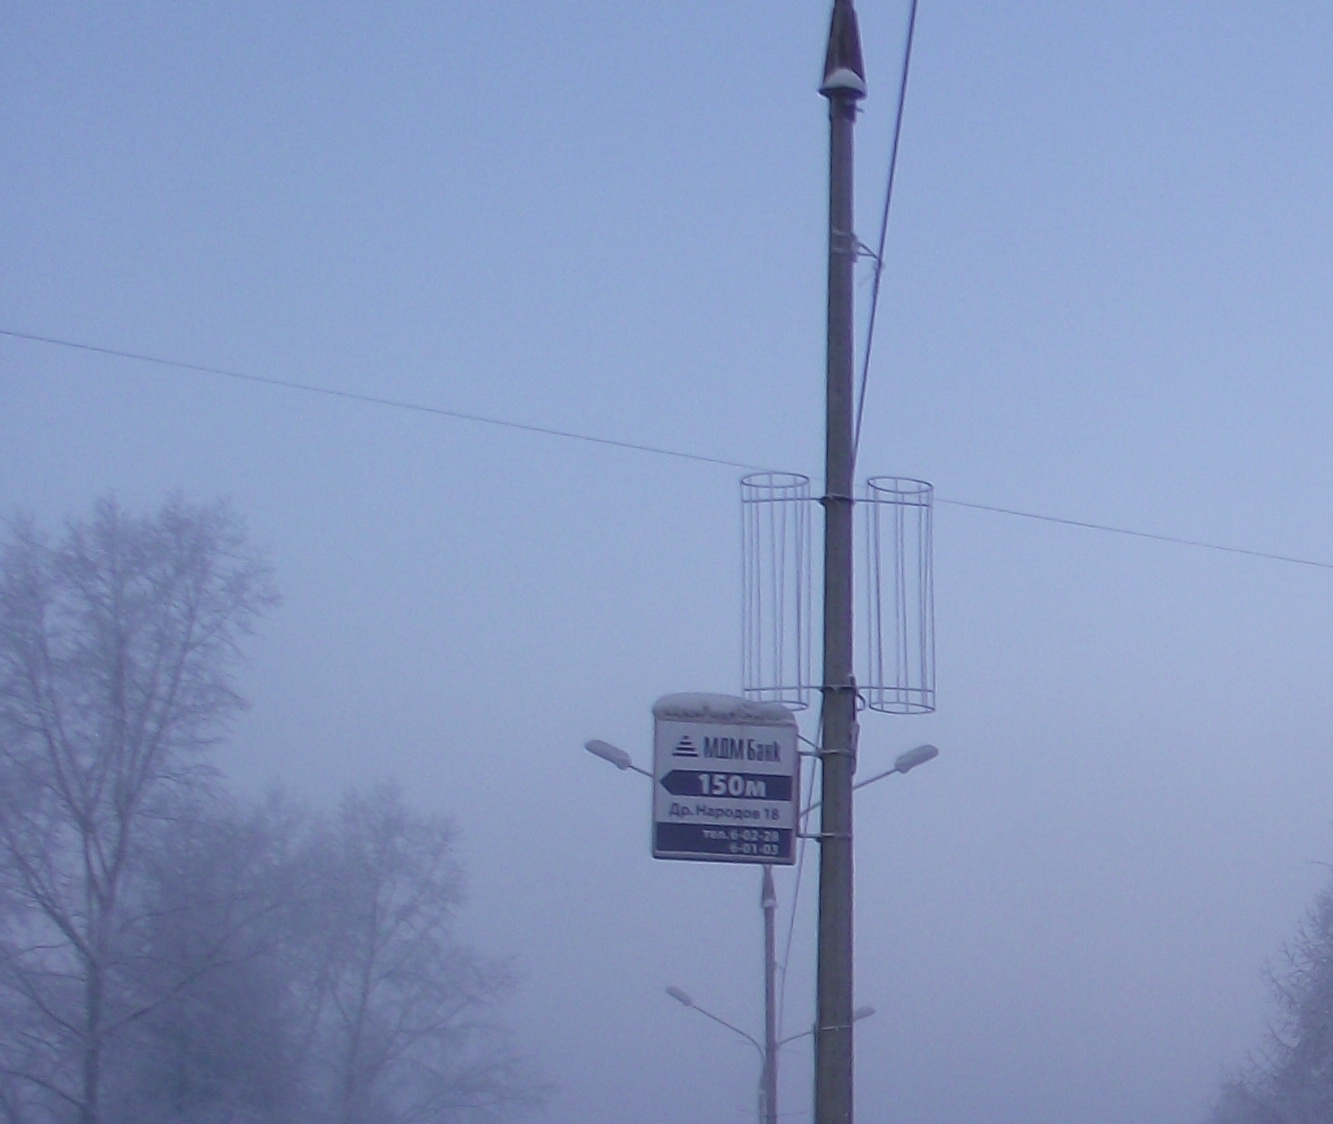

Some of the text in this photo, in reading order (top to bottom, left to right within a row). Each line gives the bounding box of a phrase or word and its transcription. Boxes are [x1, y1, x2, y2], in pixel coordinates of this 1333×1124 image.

[703, 736, 744, 761] МДМ
[669, 802, 780, 821] Др. Народов 18
